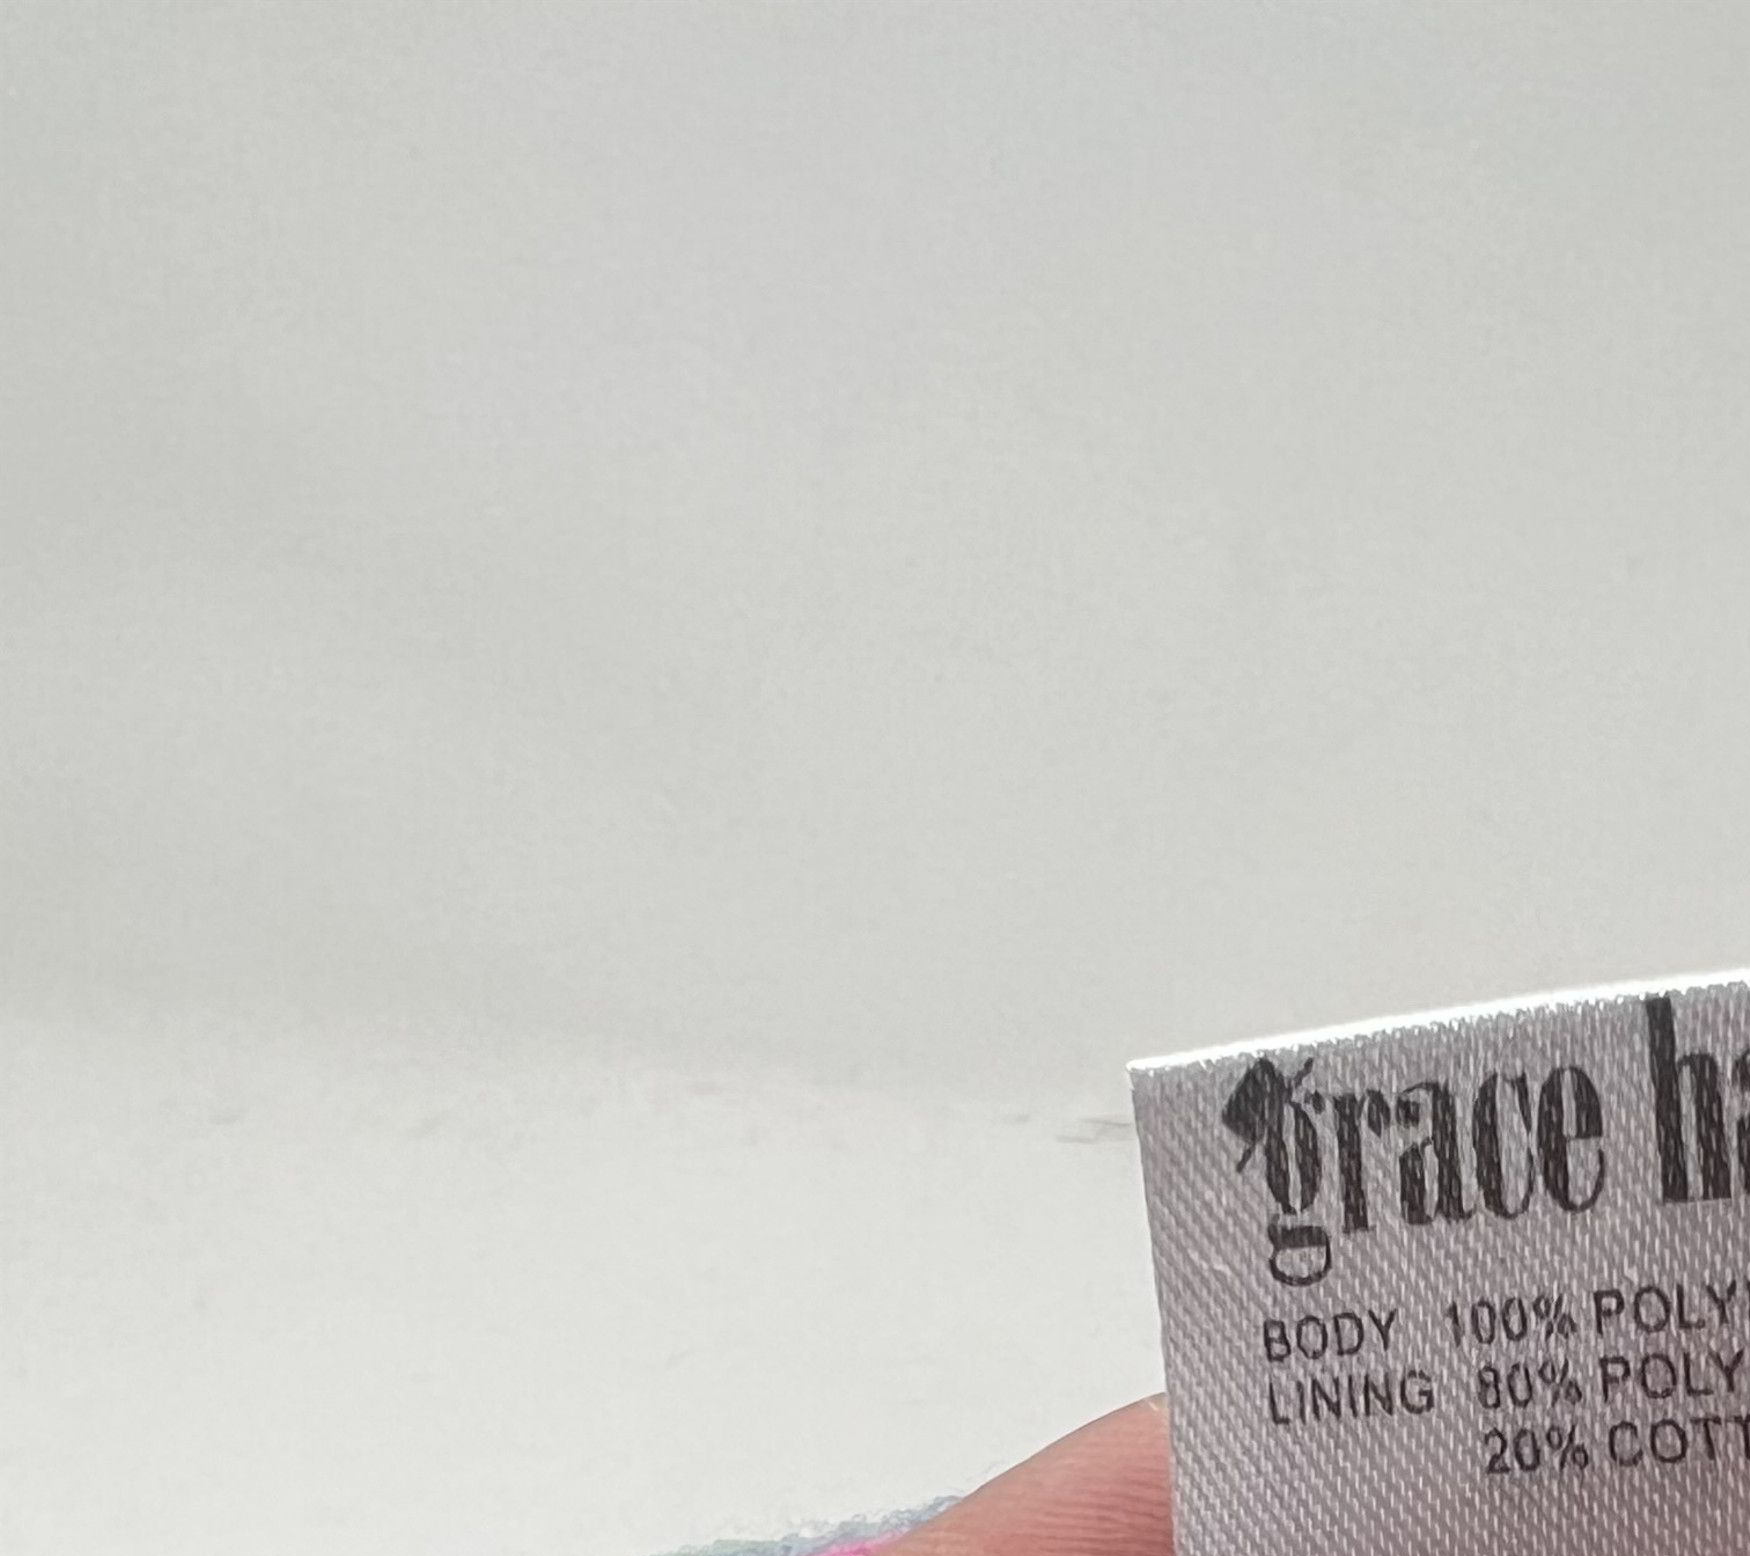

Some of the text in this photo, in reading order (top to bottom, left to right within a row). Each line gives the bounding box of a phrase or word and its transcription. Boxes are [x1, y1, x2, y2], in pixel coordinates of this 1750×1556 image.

[1222, 1056, 1606, 1287] grace
[1263, 1308, 1397, 1363] BODY
[1448, 1294, 1578, 1349] 100%
[1268, 1368, 1435, 1426] LINING
[1477, 1357, 1583, 1410] 80%
[1483, 1424, 1589, 1475] 20%
